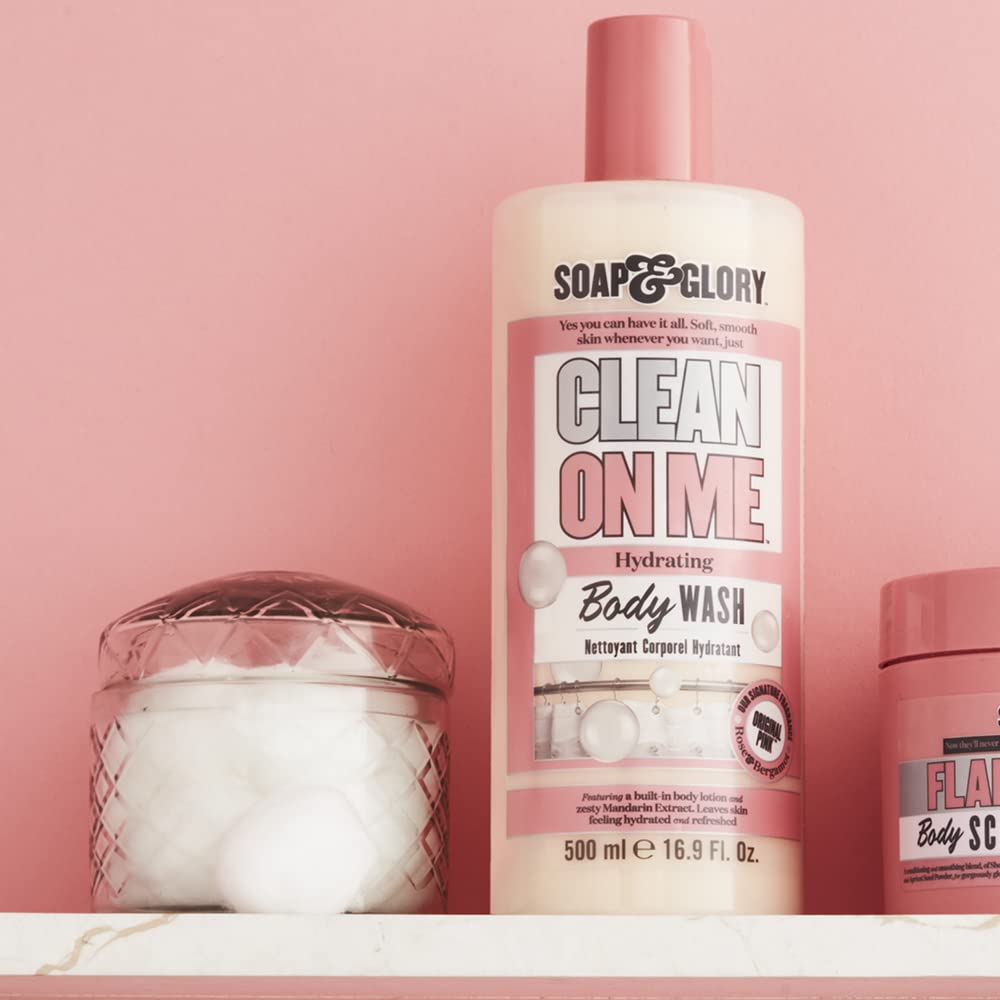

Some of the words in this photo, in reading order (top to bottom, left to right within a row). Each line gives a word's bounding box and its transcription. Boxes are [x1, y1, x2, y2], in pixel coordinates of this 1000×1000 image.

[554, 254, 767, 304] SOAP&GLORY
[560, 320, 578, 331] Yes
[580, 320, 601, 332] you
[603, 320, 625, 328] can
[628, 317, 657, 328] have
[659, 317, 669, 328] it
[670, 317, 688, 329] all.
[690, 319, 717, 332] Soft,
[719, 322, 757, 335] smooth
[577, 333, 602, 345] skin
[604, 332, 664, 344] whenever
[666, 335, 689, 347] you
[691, 336, 722, 347] want,
[722, 336, 744, 349] just
[556, 357, 761, 448] CLEAN
[559, 451, 655, 540] ON
[666, 451, 765, 544] ME
[615, 552, 714, 573] Hydrating
[579, 580, 676, 634] Body
[679, 584, 745, 625] WASH
[585, 639, 638, 657] Nettoyant
[642, 639, 687, 657] Corporel
[692, 640, 741, 658] Hydratant
[735, 726, 748, 757] Rose
[582, 793, 623, 803] Featuring
[634, 791, 671, 800] built-in
[673, 791, 698, 803] body
[700, 791, 727, 802] lotion
[576, 804, 601, 815] zesty
[603, 803, 652, 812] Mandarin
[655, 803, 695, 813] Extract.
[697, 804, 728, 814] Leaves
[730, 805, 748, 815] skin
[589, 814, 622, 826] feeling
[624, 814, 671, 826] hydrated
[692, 815, 737, 826] refreshed
[917, 817, 965, 853] Body
[564, 839, 596, 861] 500
[604, 839, 626, 860] ml
[663, 838, 702, 861] 16.9
[710, 840, 730, 861] Fl.
